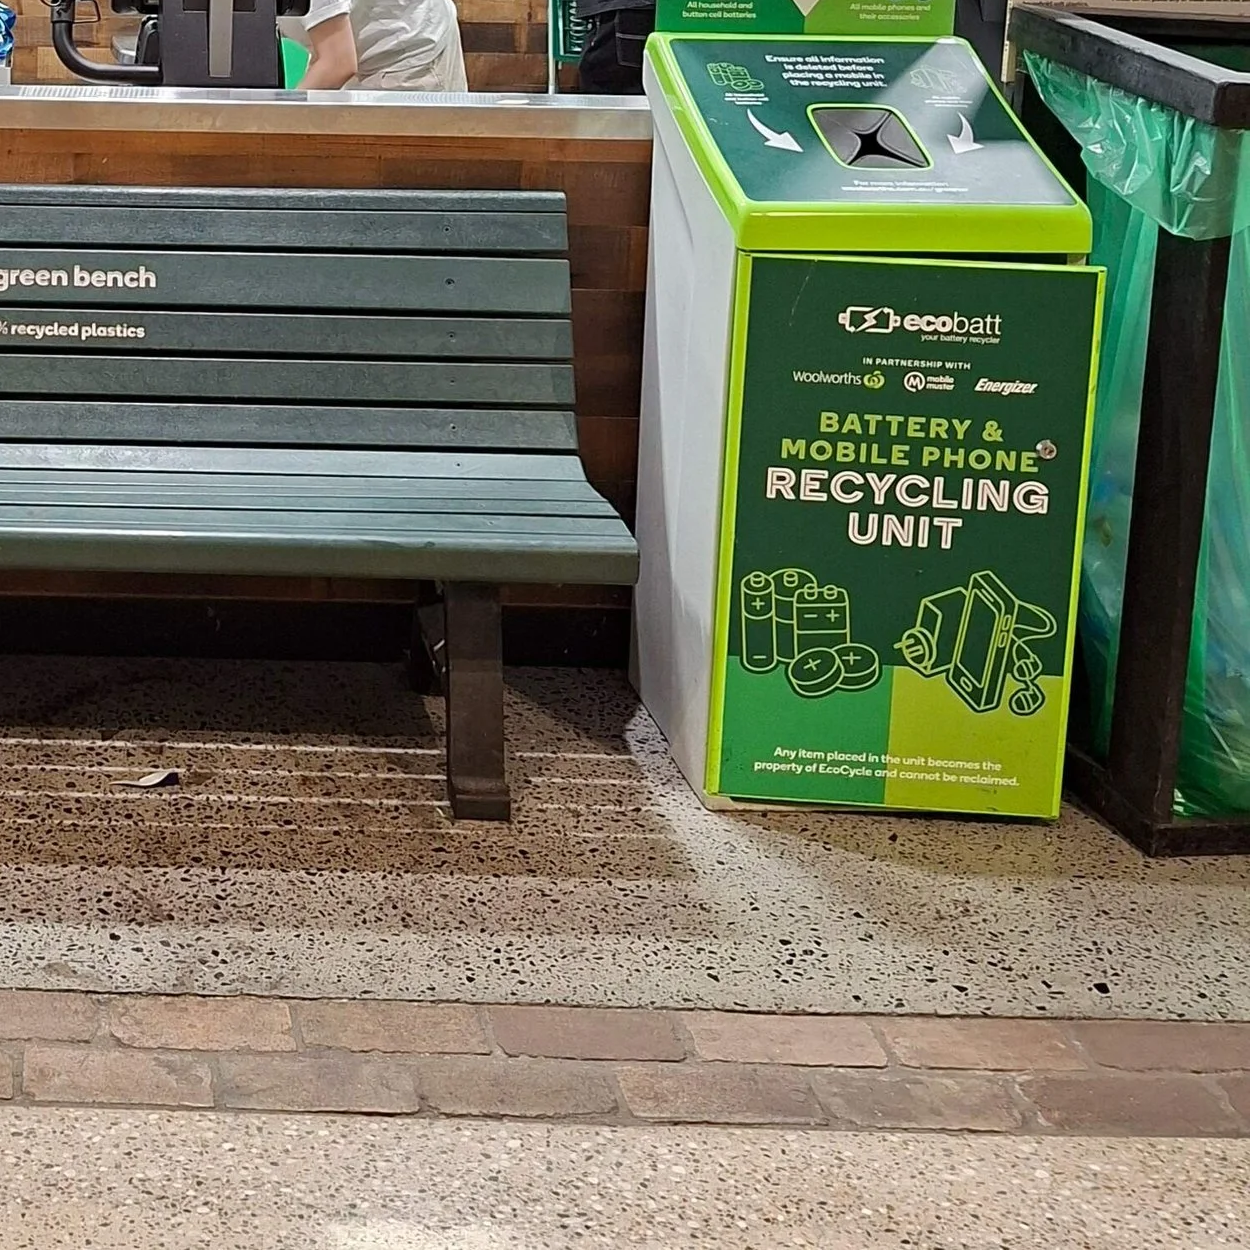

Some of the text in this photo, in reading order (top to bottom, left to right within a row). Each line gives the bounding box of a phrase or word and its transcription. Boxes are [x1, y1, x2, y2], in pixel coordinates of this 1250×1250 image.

[723, 11, 757, 19] batteries
[887, 4, 915, 12] phones
[764, 54, 885, 64] Ensure all information
[783, 63, 794, 71] is
[795, 63, 837, 71] deleted
[782, 71, 824, 80] placing
[810, 80, 862, 88] recycling
[74, 265, 157, 288] bench
[10, 322, 79, 338] recycled
[81, 323, 146, 340] plastics
[903, 312, 1002, 335] ecobatt
[921, 333, 1000, 344] your battery recycler
[863, 357, 971, 370] IN PARTNERSHIP WITH
[793, 370, 1038, 395] Woolworths Energizer
[926, 375, 954, 384] mobile
[926, 382, 955, 391] muster
[820, 411, 1004, 442] BATTERY &
[781, 438, 1039, 473] MOBILE PHONE
[766, 466, 1050, 514] RECYCLING
[848, 511, 963, 550] UNIT
[774, 746, 1001, 771] Any item placed in the unit becomes the
[754, 761, 1019, 786] property of EcoCycle and cannot be reclaimed.
